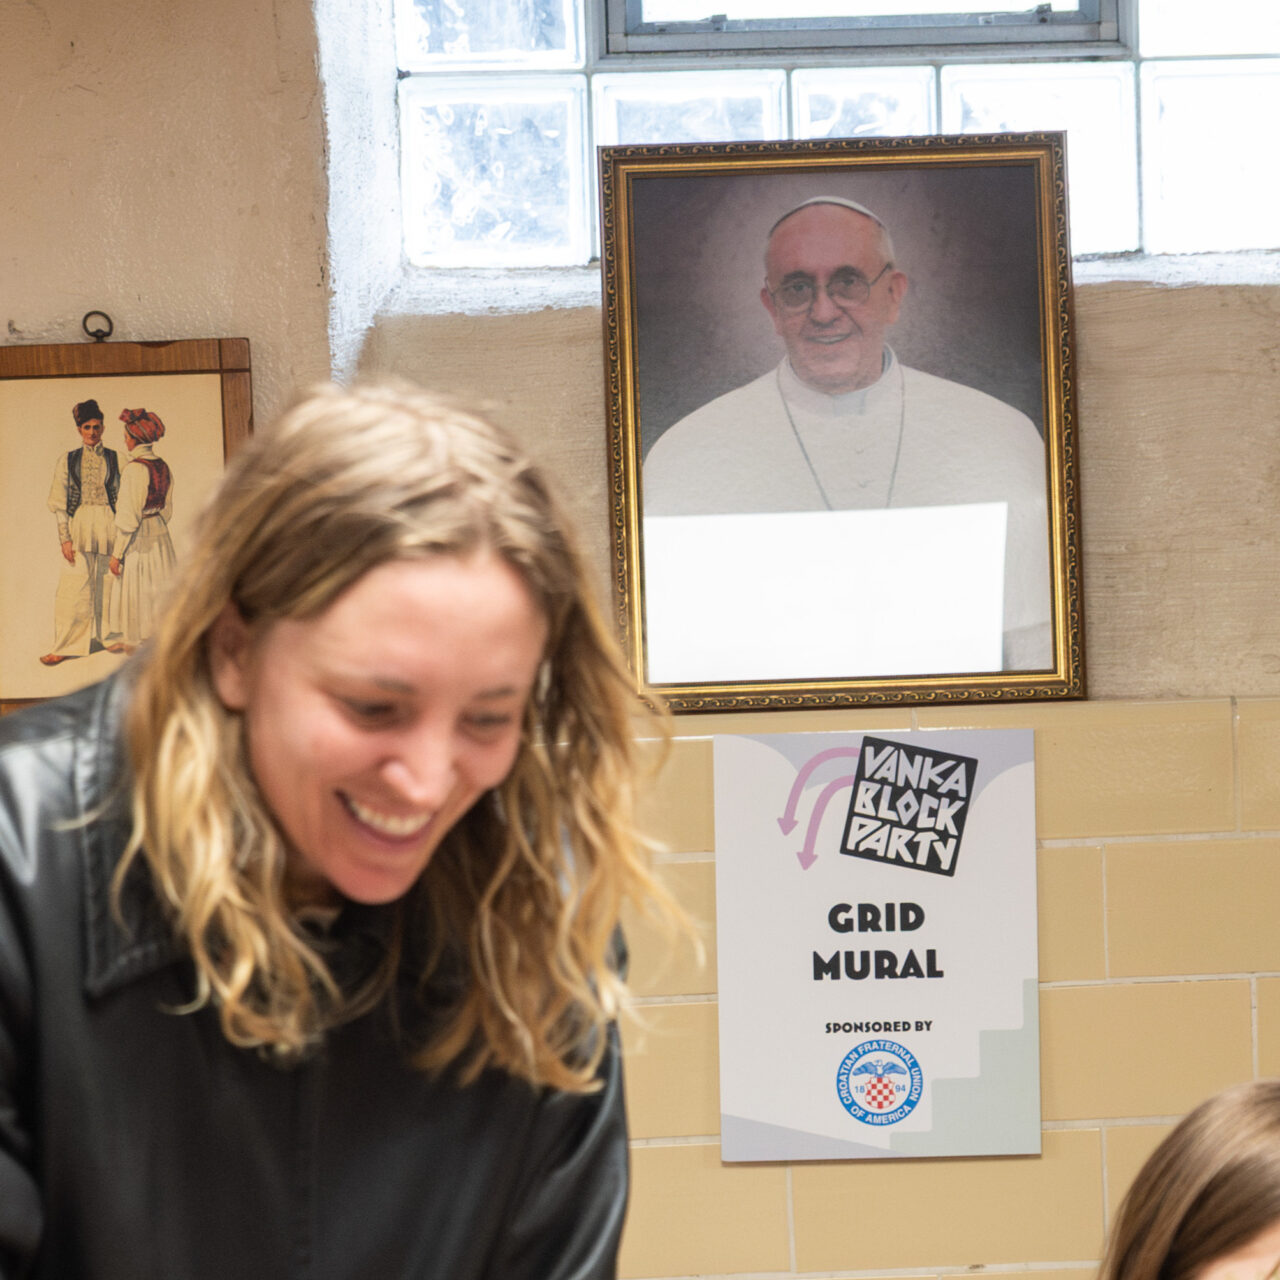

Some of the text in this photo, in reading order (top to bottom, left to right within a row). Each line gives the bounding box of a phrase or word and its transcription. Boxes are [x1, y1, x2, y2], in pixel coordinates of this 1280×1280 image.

[864, 745, 967, 798] VANKA
[853, 780, 966, 837] BLOCK
[846, 815, 957, 871] PARTY
[828, 902, 925, 933] GRID
[813, 948, 944, 980] MURAL
[825, 1020, 932, 1033] SPONSORED BY
[839, 1042, 921, 1104] CROATIAN FRATERNAL UNION
[855, 1084, 906, 1094] 18 94
[851, 1105, 912, 1124] OF AMERICA
